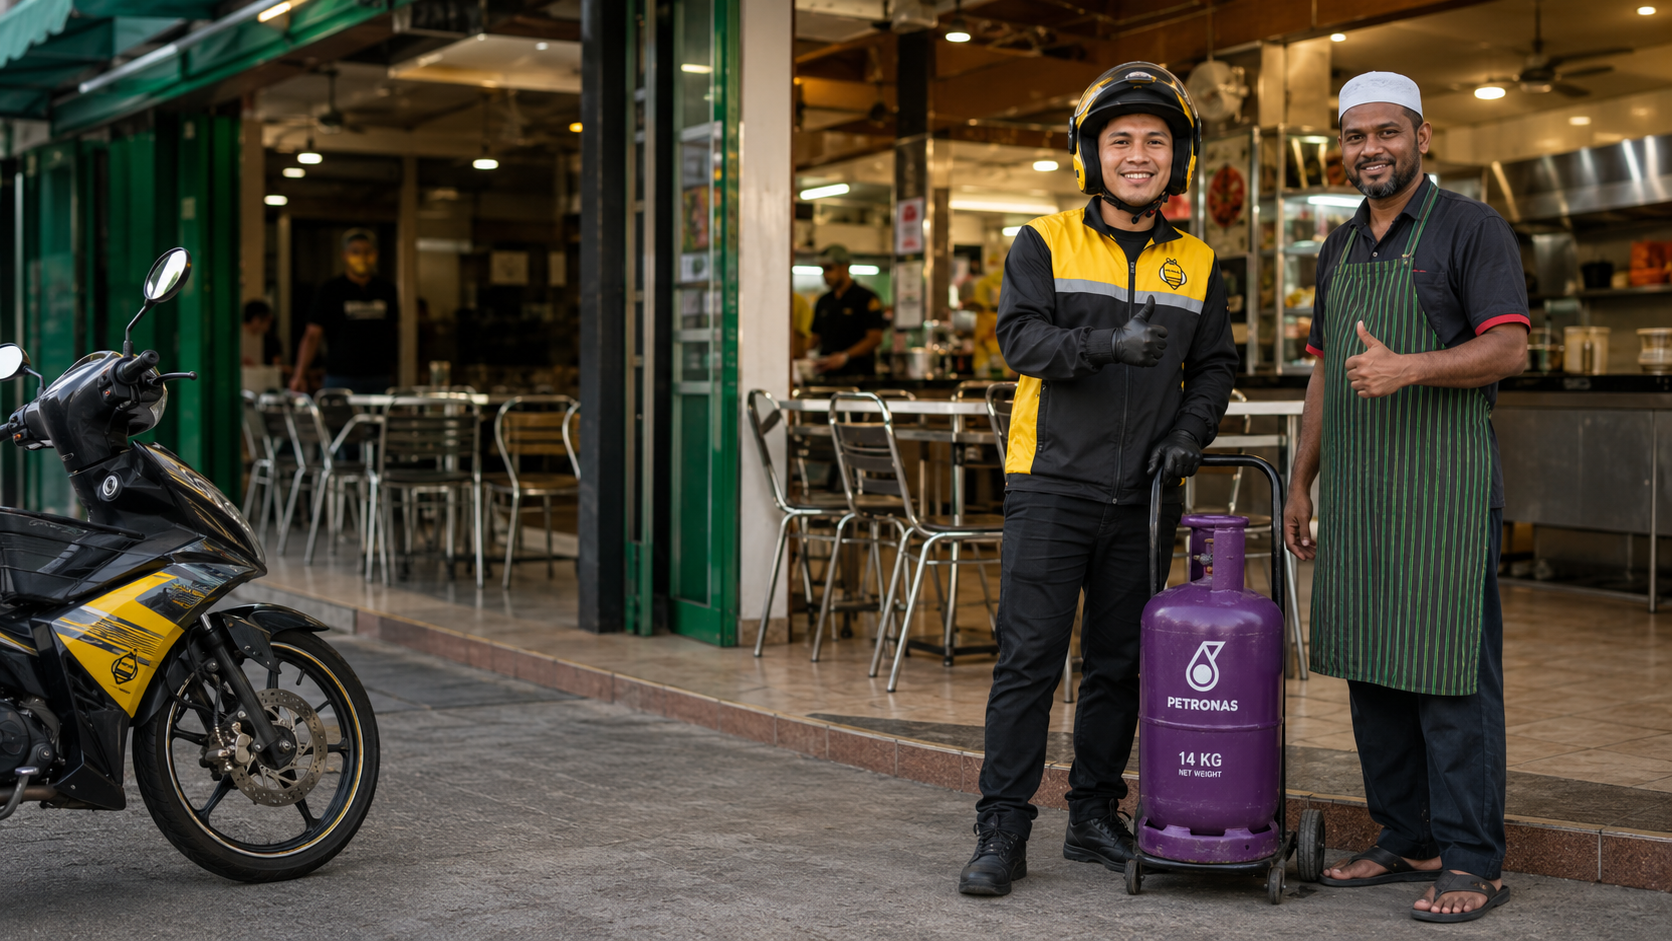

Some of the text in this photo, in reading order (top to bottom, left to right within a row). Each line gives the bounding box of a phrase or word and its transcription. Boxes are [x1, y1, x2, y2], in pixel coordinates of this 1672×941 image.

[1167, 696, 1238, 712] PETRONAS
[1178, 751, 1222, 767] 14 KG
[1178, 769, 1222, 778] NET WEIGHT
